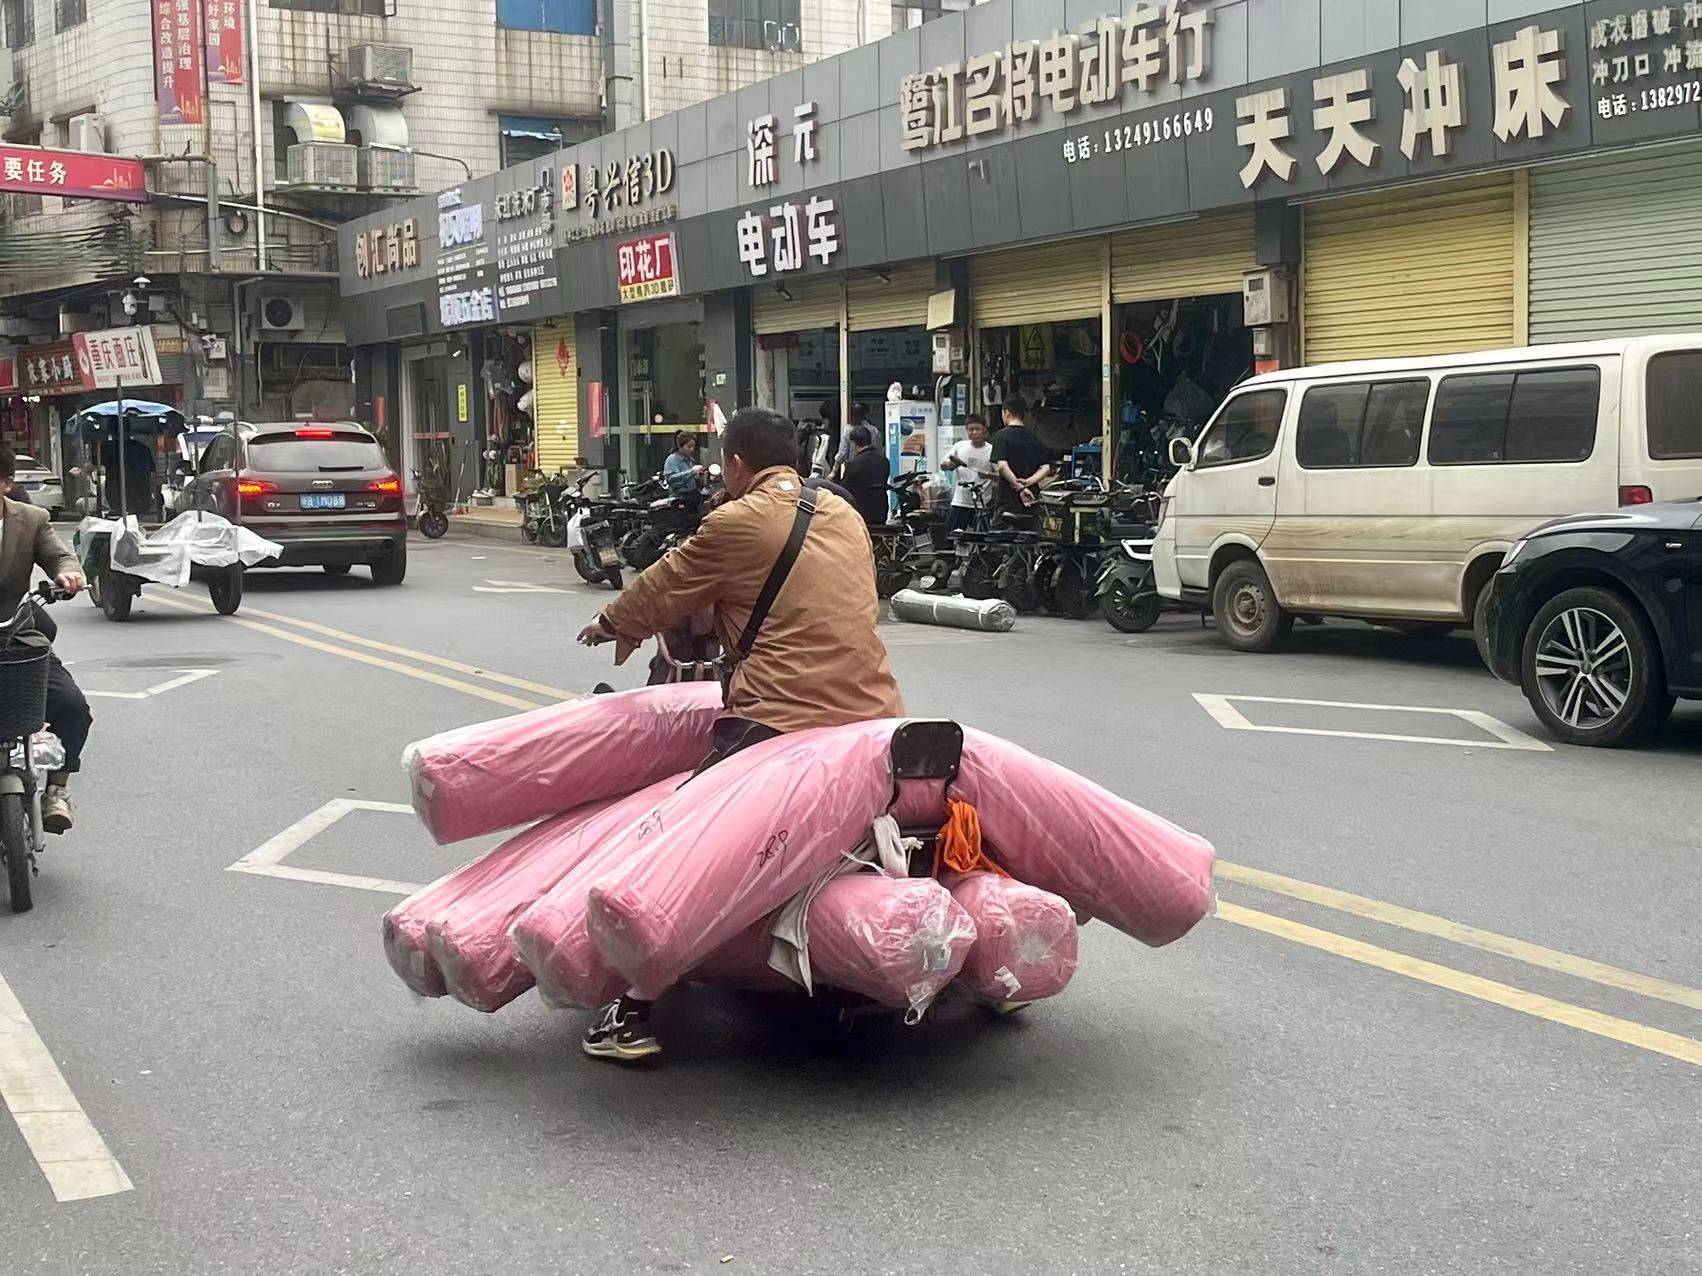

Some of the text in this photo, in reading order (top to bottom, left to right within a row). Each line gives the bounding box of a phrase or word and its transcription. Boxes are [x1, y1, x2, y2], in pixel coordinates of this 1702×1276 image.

[159, 2, 175, 89] 综合改造提升
[900, 0, 1214, 151] 鹭江名将电动车行
[1592, 53, 1650, 86] 冲刀口
[1235, 25, 1571, 189] 天天冲床
[3, 156, 67, 185] 要任务
[748, 102, 817, 186] 深元
[356, 218, 420, 278] 创汇尚品
[619, 237, 670, 283] 印花厂
[737, 196, 839, 276] 电动车
[89, 336, 139, 370] 重庆面庄
